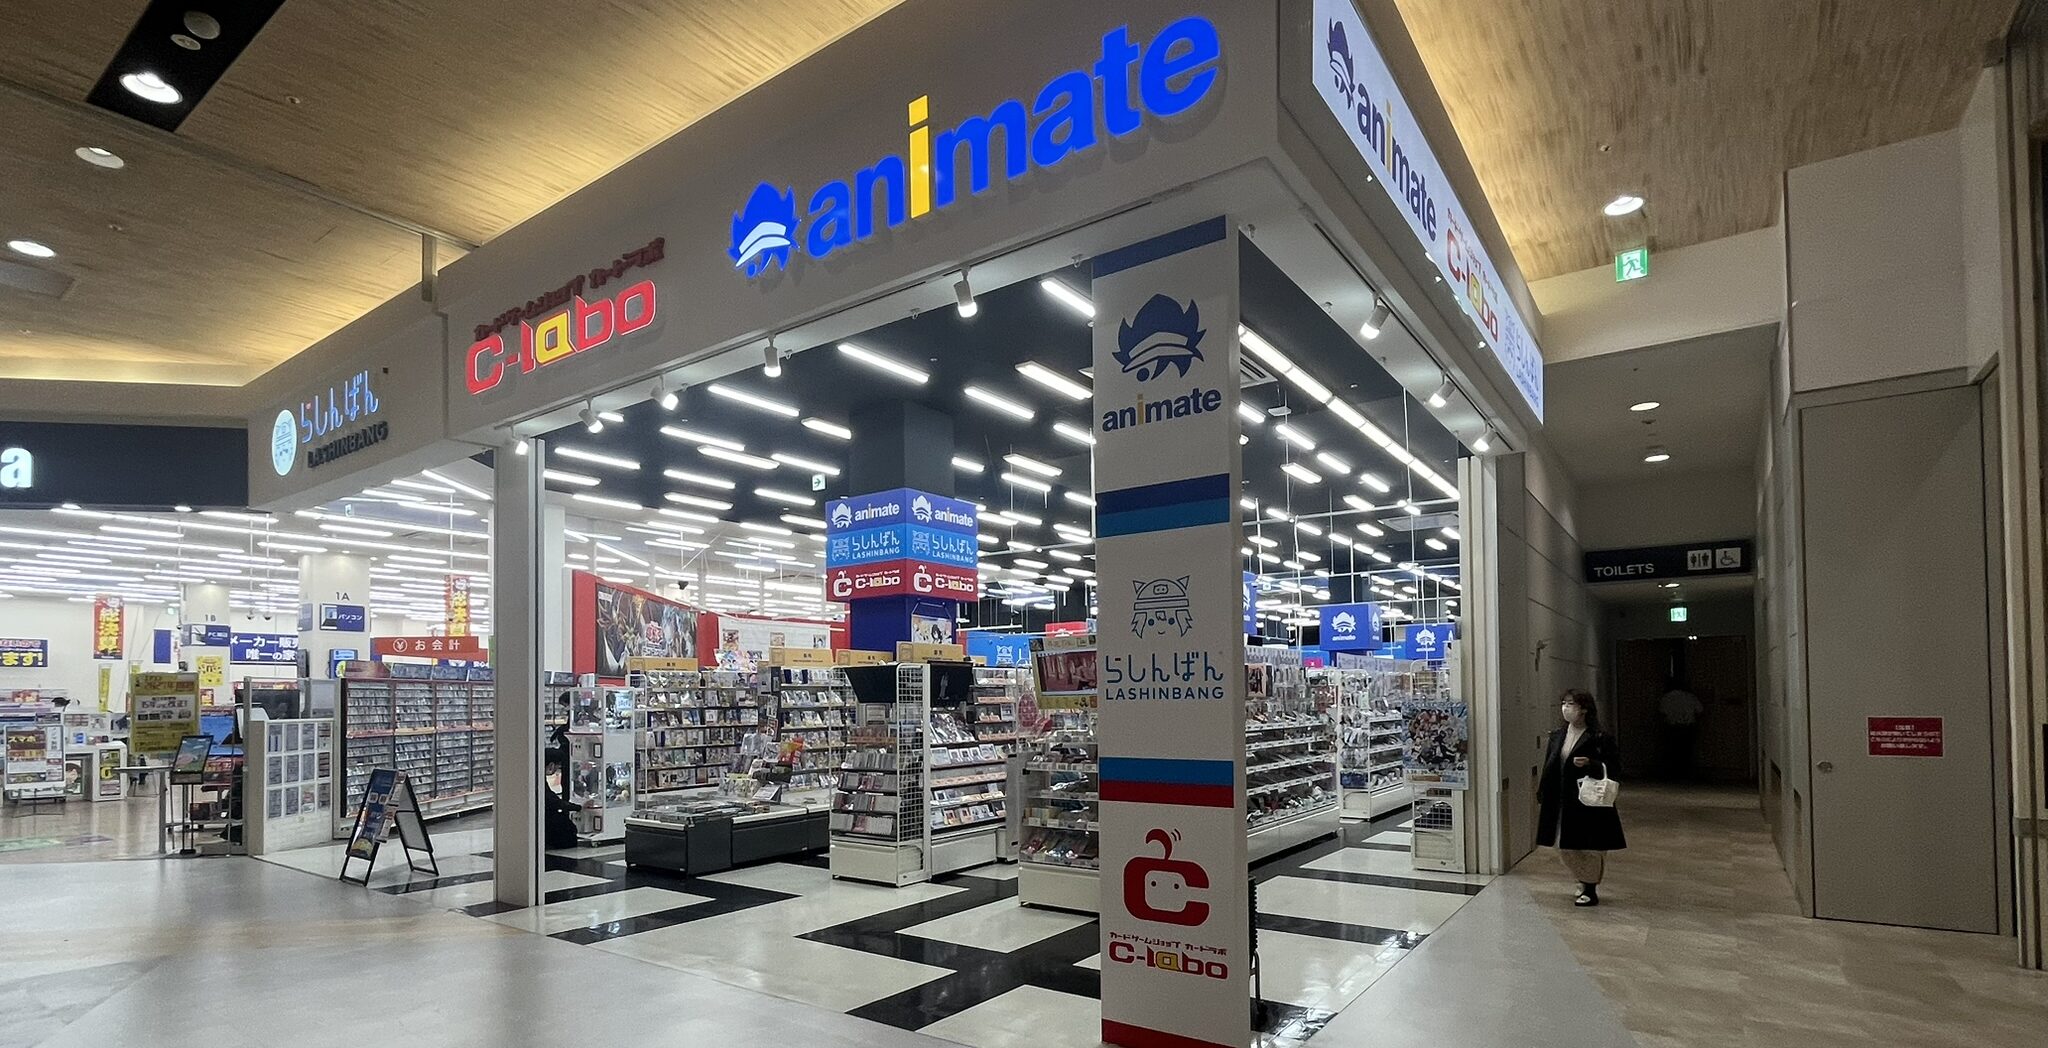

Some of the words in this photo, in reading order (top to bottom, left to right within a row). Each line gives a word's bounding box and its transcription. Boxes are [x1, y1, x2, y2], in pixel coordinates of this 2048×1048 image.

[806, 16, 1221, 260] animate
[1356, 83, 1437, 242] animate
[1446, 228, 1498, 343] C-labo
[466, 280, 656, 395] C-labo
[301, 370, 379, 443] らしんばん
[1102, 387, 1222, 432] animate
[854, 502, 900, 522] animate
[934, 507, 974, 527] animate
[852, 531, 900, 551] らしんばん
[932, 533, 974, 556] らしんばん
[852, 547, 900, 560] LASHINBANG
[932, 551, 974, 564] LASHINBANG
[1594, 563, 1655, 577] TOILETS
[855, 576, 900, 590] C-labo
[935, 577, 974, 592] C-labo
[336, 592, 350, 601] 1A
[338, 613, 363, 621] パソコン
[415, 639, 460, 651] お会計
[0, 652, 43, 666] ます!
[1105, 652, 1224, 683] らしんばん
[1106, 686, 1224, 700] LASHINBANG
[1109, 941, 1228, 980] C-labo
